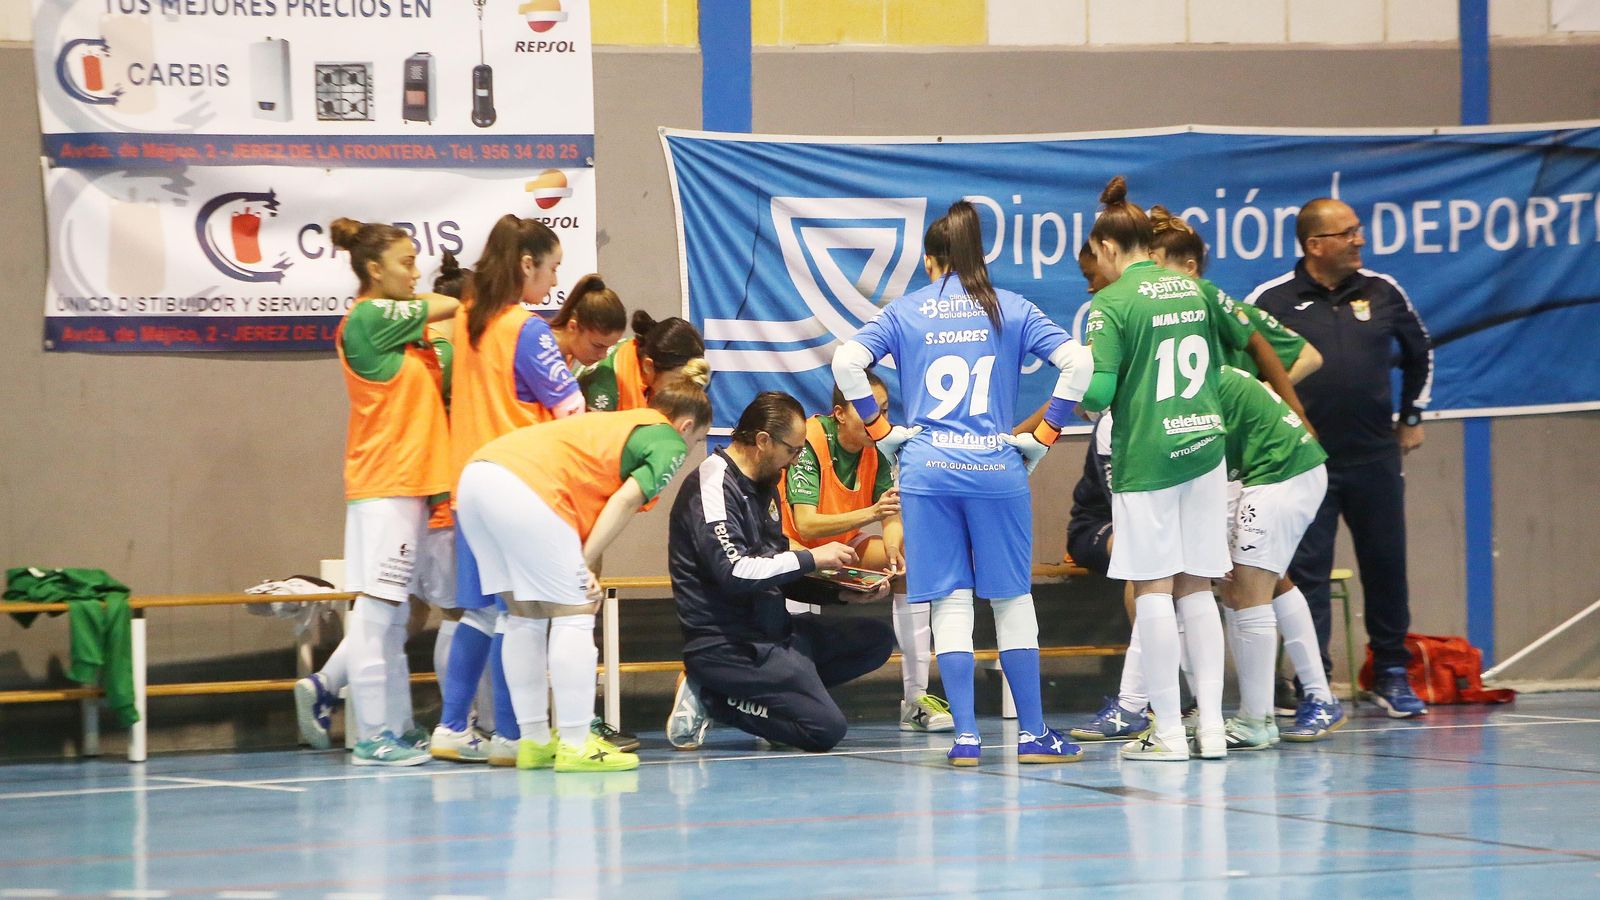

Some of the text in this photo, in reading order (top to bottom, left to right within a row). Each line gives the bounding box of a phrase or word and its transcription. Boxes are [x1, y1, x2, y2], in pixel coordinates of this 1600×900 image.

[161, 0, 277, 16] MEJORES
[286, 0, 391, 18] PRECIOS
[400, 0, 432, 18] EN
[514, 41, 576, 53] REPSOL
[127, 62, 230, 87] CARBIS
[231, 143, 286, 159] JEREZ
[290, 143, 313, 159] DE
[316, 144, 338, 159] LA
[343, 144, 436, 160] FRONTERA
[449, 144, 477, 160] Tel.
[482, 144, 509, 159] 956
[513, 144, 533, 159] 34
[536, 144, 555, 160] 28
[559, 144, 579, 160] 25
[534, 216, 579, 228] PSOL
[1374, 192, 1600, 256] DEPORT
[298, 220, 463, 260] CBIS
[240, 296, 253, 312] Y
[257, 296, 337, 312] SERVICIO
[1180, 309, 1206, 323] SOJO
[206, 325, 217, 342] 2
[234, 325, 291, 341] JEREZ
[294, 325, 315, 341] DE
[925, 329, 990, 345] S.SOARES
[1154, 334, 1210, 402] 19
[925, 355, 996, 420] 91
